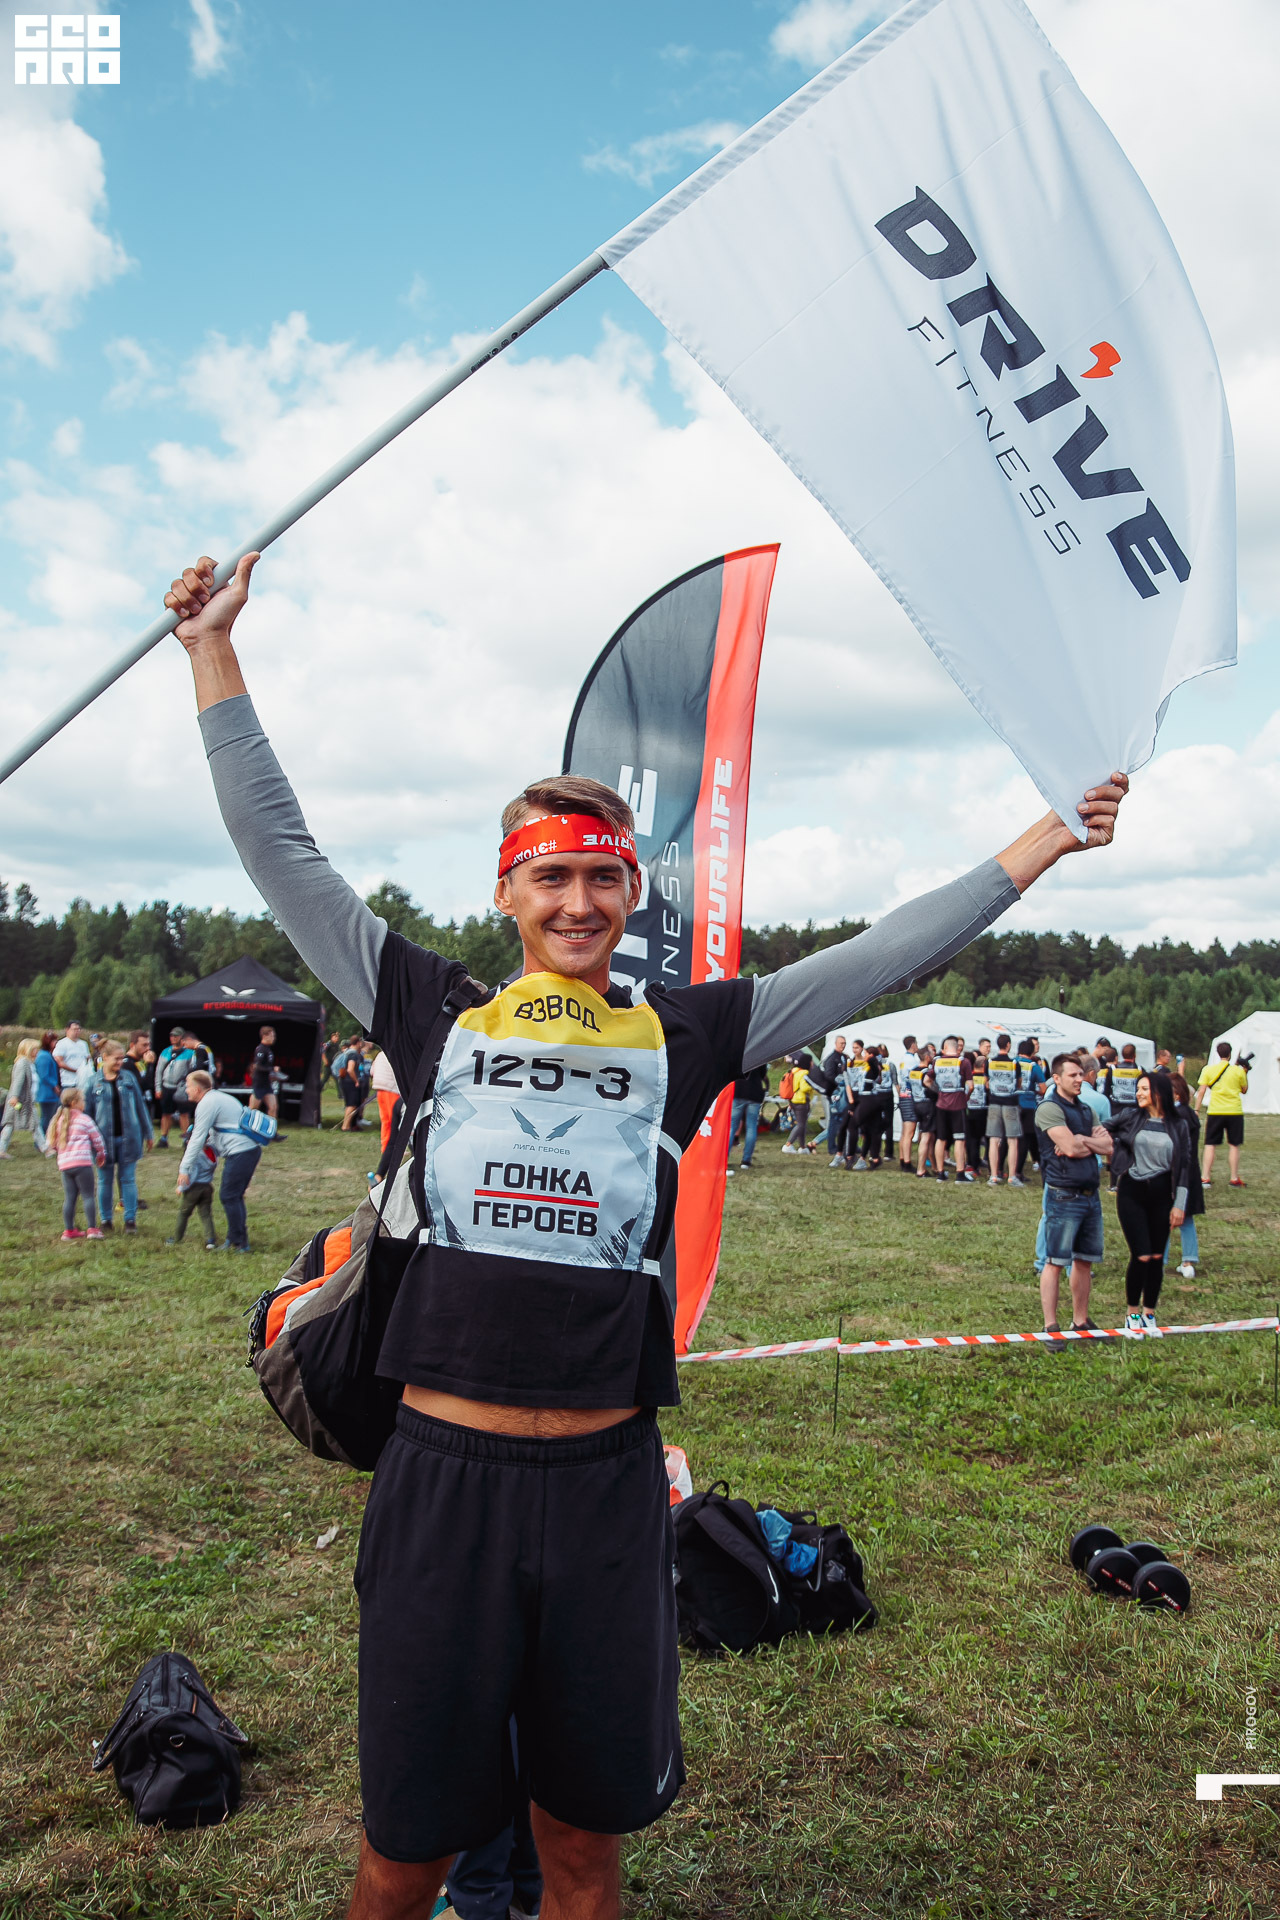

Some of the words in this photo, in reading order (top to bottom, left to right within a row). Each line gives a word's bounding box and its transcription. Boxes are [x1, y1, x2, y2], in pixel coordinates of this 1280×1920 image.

[874, 185, 1191, 599] DRIVE
[907, 316, 1081, 555] FITNESS
[660, 841, 682, 985] NESS
[514, 994, 602, 1033] ВЗВОД
[472, 1049, 632, 1101] 125-3
[513, 1143, 536, 1152] ЛИГА
[538, 1145, 571, 1156] ГЕРОЕВ
[483, 1161, 594, 1197] ГОНКА
[472, 1201, 598, 1237] ГЕРОЕВ
